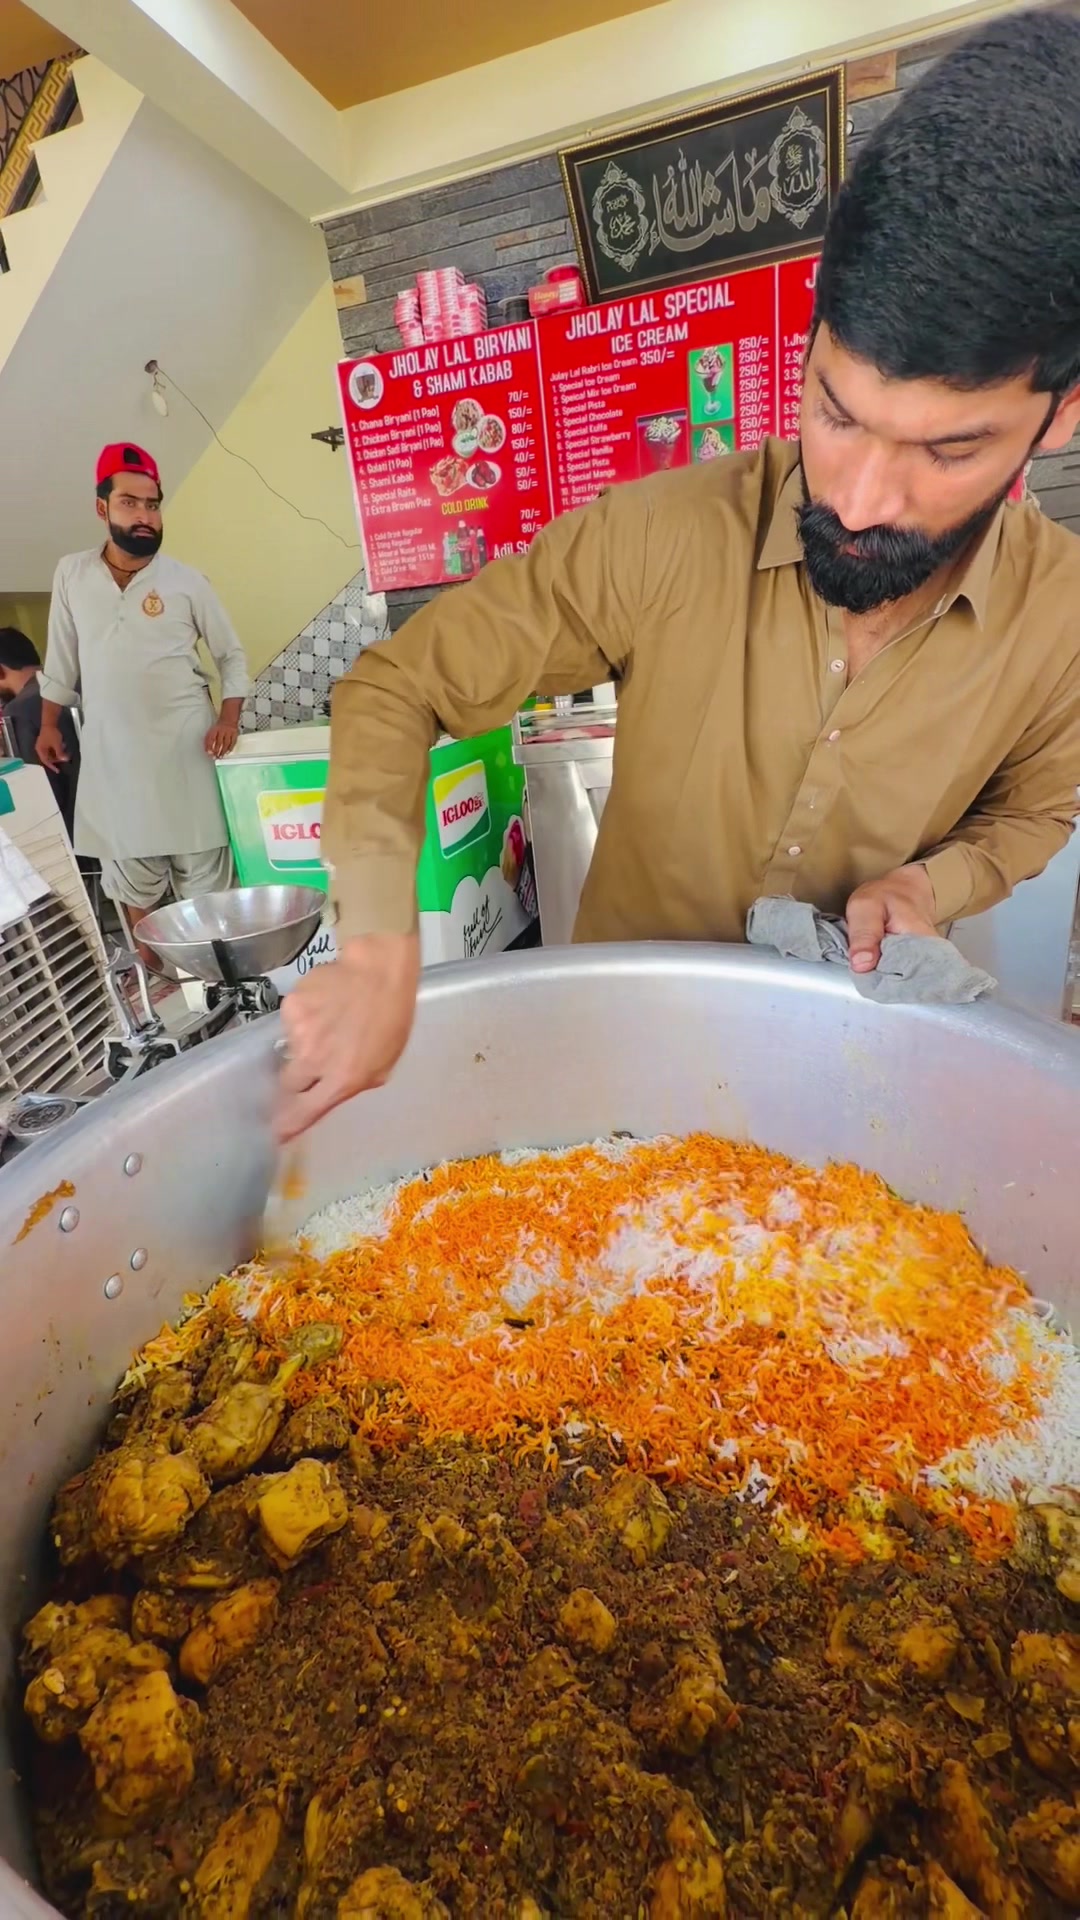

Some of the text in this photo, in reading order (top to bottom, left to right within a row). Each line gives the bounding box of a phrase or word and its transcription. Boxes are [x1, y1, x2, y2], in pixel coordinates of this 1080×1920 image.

[565, 282, 735, 340] JHOLAY LAL SPECIAL
[611, 322, 689, 354] ICE CREAM
[739, 335, 768, 350] 250/=
[389, 326, 532, 379] JHOLAY LAL BIRYANI
[602, 362, 613, 372] Ice
[614, 358, 638, 368] Cream
[640, 347, 675, 366] 350/=
[739, 348, 768, 364] 250/=
[739, 362, 768, 378] 250/=
[412, 360, 512, 398] & SHAMI KABAB
[559, 380, 583, 393] Special
[585, 378, 596, 386] Ice
[597, 374, 620, 385] Cream
[739, 376, 768, 392] 250/=
[508, 390, 529, 403] 70/=
[587, 387, 600, 398] Mix
[601, 385, 612, 396] Ice
[613, 382, 637, 394] Cream
[739, 388, 768, 404] 250/=
[508, 405, 532, 420] 150/=
[562, 404, 586, 416] Special
[563, 415, 588, 428] Special
[588, 408, 623, 422] Chocolate
[740, 402, 770, 418] 250/=
[358, 417, 384, 431] Chana
[384, 410, 412, 426] Biryani
[512, 422, 532, 435] 80/=
[740, 416, 770, 430] 250/=
[362, 432, 390, 446] Chicken
[390, 426, 416, 441] Biryani
[564, 426, 588, 440] Special
[565, 438, 590, 450] Special
[590, 431, 631, 445] Strawberry
[400, 440, 422, 454] Biryani
[511, 436, 536, 450] 150/=
[514, 451, 536, 464] 40/=
[566, 449, 590, 462] Special
[516, 466, 536, 478] 50/=
[566, 460, 591, 473] Special
[368, 476, 392, 488] Shami
[392, 472, 414, 484] Kabab
[517, 479, 538, 491] 50/=
[568, 471, 592, 484] Special
[370, 490, 396, 504] Special
[391, 500, 416, 512] Brown
[442, 496, 490, 516] COLD DRINK
[520, 508, 541, 520] 70/=
[521, 522, 542, 534] 80/=
[442, 797, 475, 827] IGLOO
[272, 823, 321, 841] IGLO
